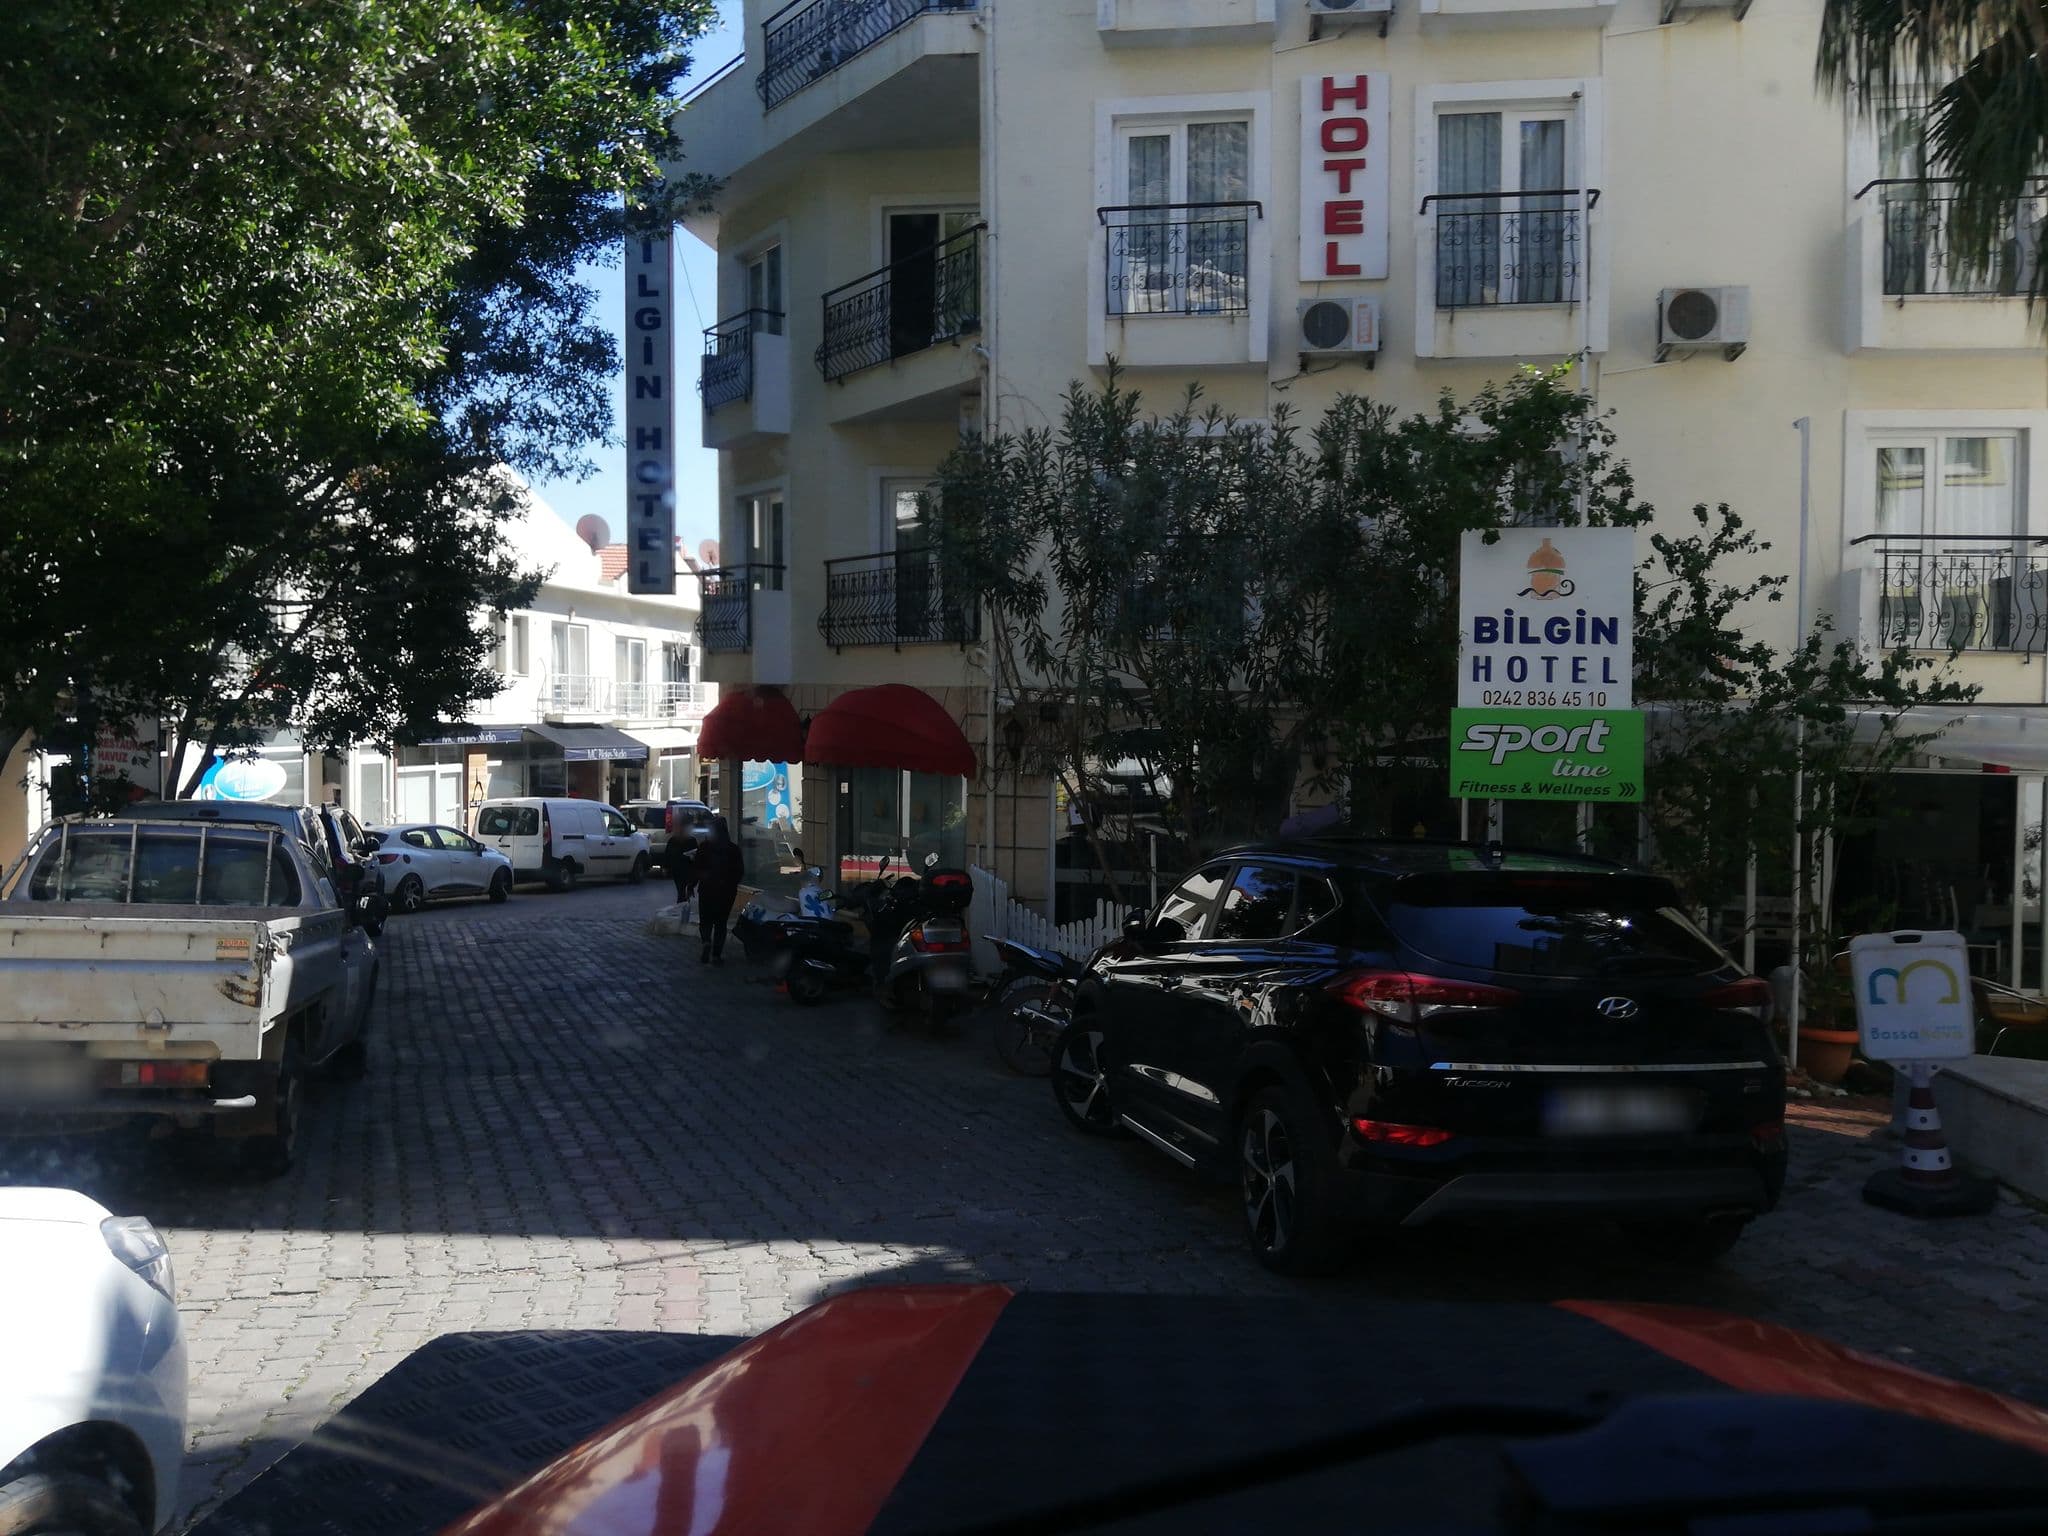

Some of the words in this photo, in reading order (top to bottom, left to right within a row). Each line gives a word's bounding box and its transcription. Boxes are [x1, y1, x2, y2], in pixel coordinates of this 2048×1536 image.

[1320, 75, 1369, 276] HOTEL
[635, 426, 663, 585] HOTEL
[1472, 656, 1618, 684] HOTEL
[1483, 691, 1522, 707] 0242
[1527, 691, 1557, 707] 836
[1562, 691, 1581, 707] 45
[1588, 691, 1607, 707] 10
[1459, 719, 1611, 765] sport
[1551, 759, 1611, 778] line
[1459, 781, 1517, 794] Fitness
[1521, 782, 1532, 794] &
[1537, 782, 1611, 796] Wellness
